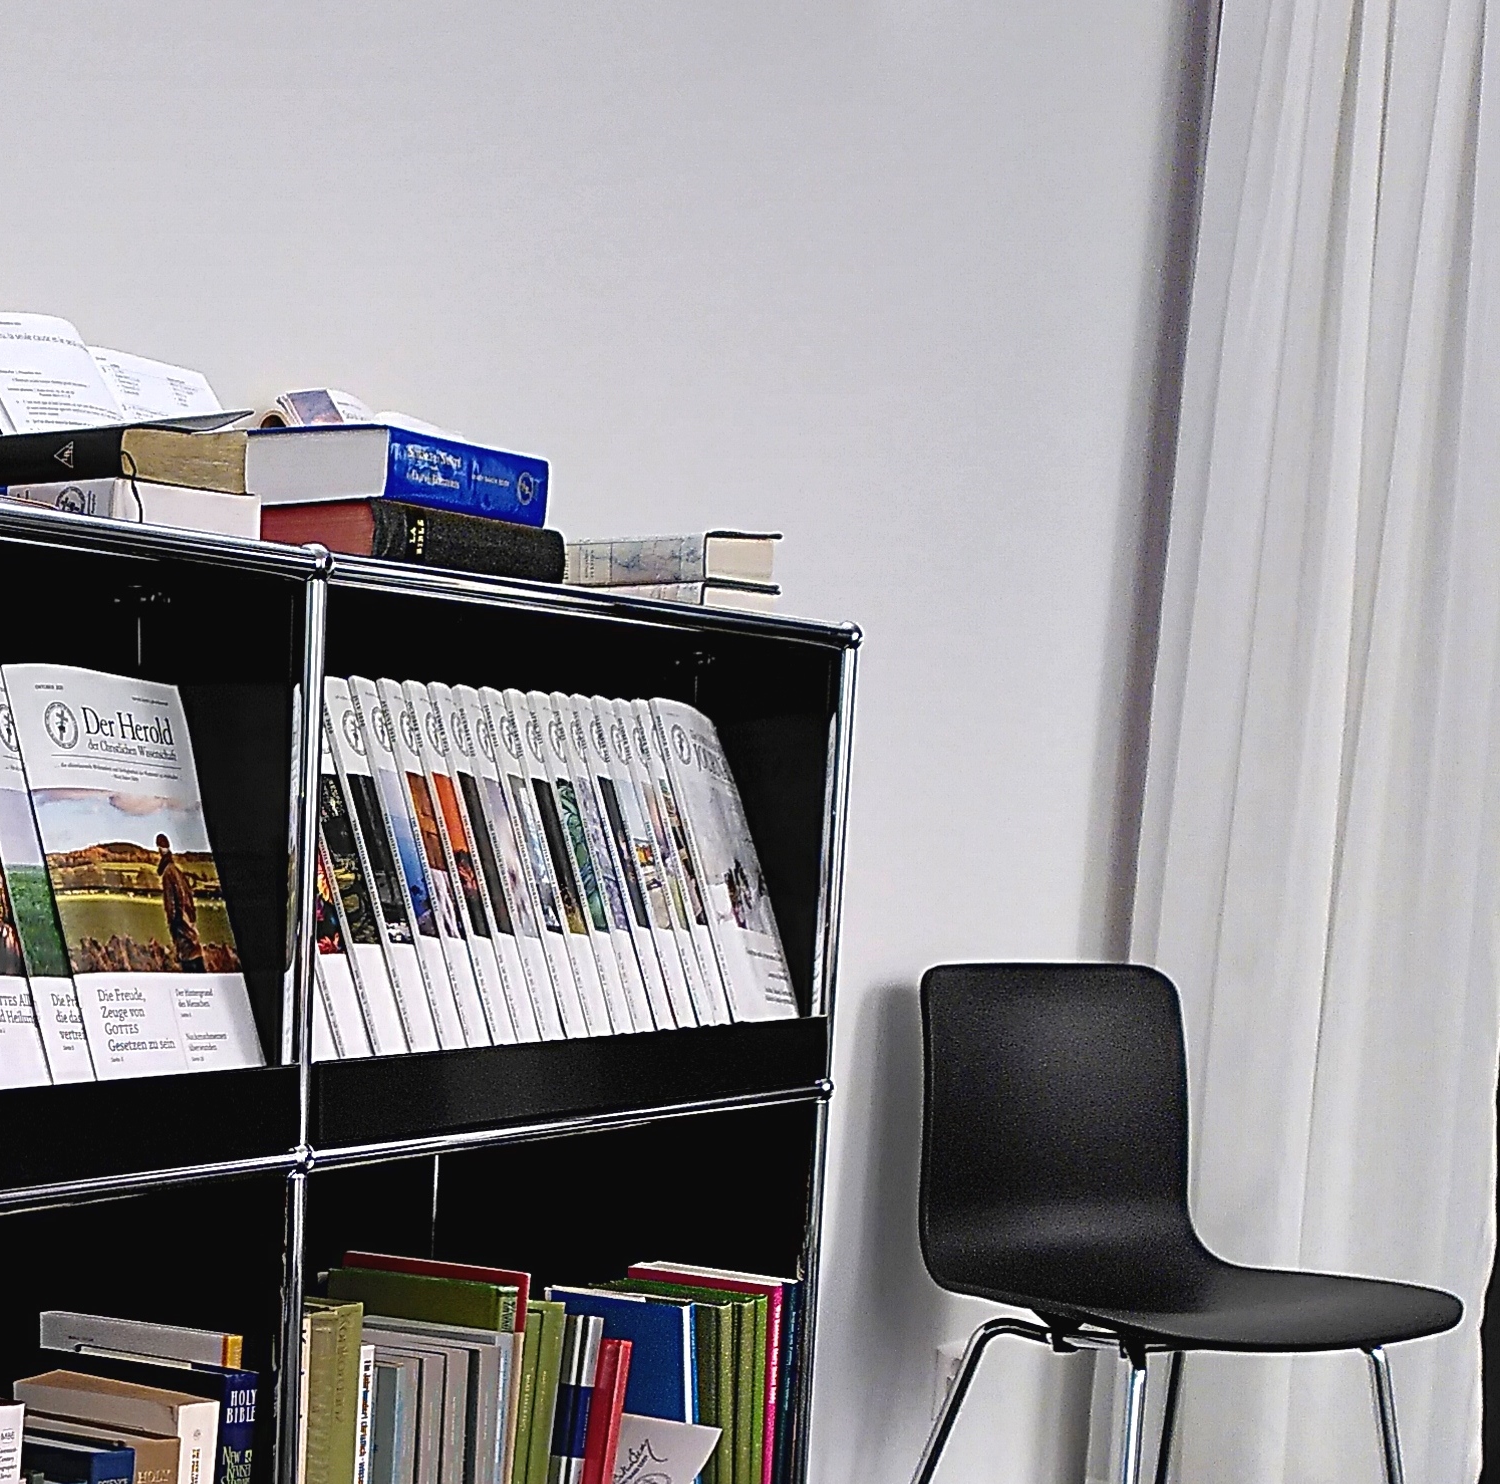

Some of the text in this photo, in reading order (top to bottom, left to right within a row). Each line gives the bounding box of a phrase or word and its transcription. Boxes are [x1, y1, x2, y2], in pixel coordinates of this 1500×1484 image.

[409, 527, 416, 543] LA
[416, 519, 424, 555] BIBLE
[81, 706, 174, 746] Der Herold
[97, 988, 146, 1002] Die Freude,
[100, 1007, 145, 1021] Zeuge von
[108, 1038, 176, 1052] Gesetzen zu sein
[231, 1390, 257, 1406] HOLY
[226, 1406, 256, 1424] BIBLE
[137, 1470, 171, 1484] HOLY
